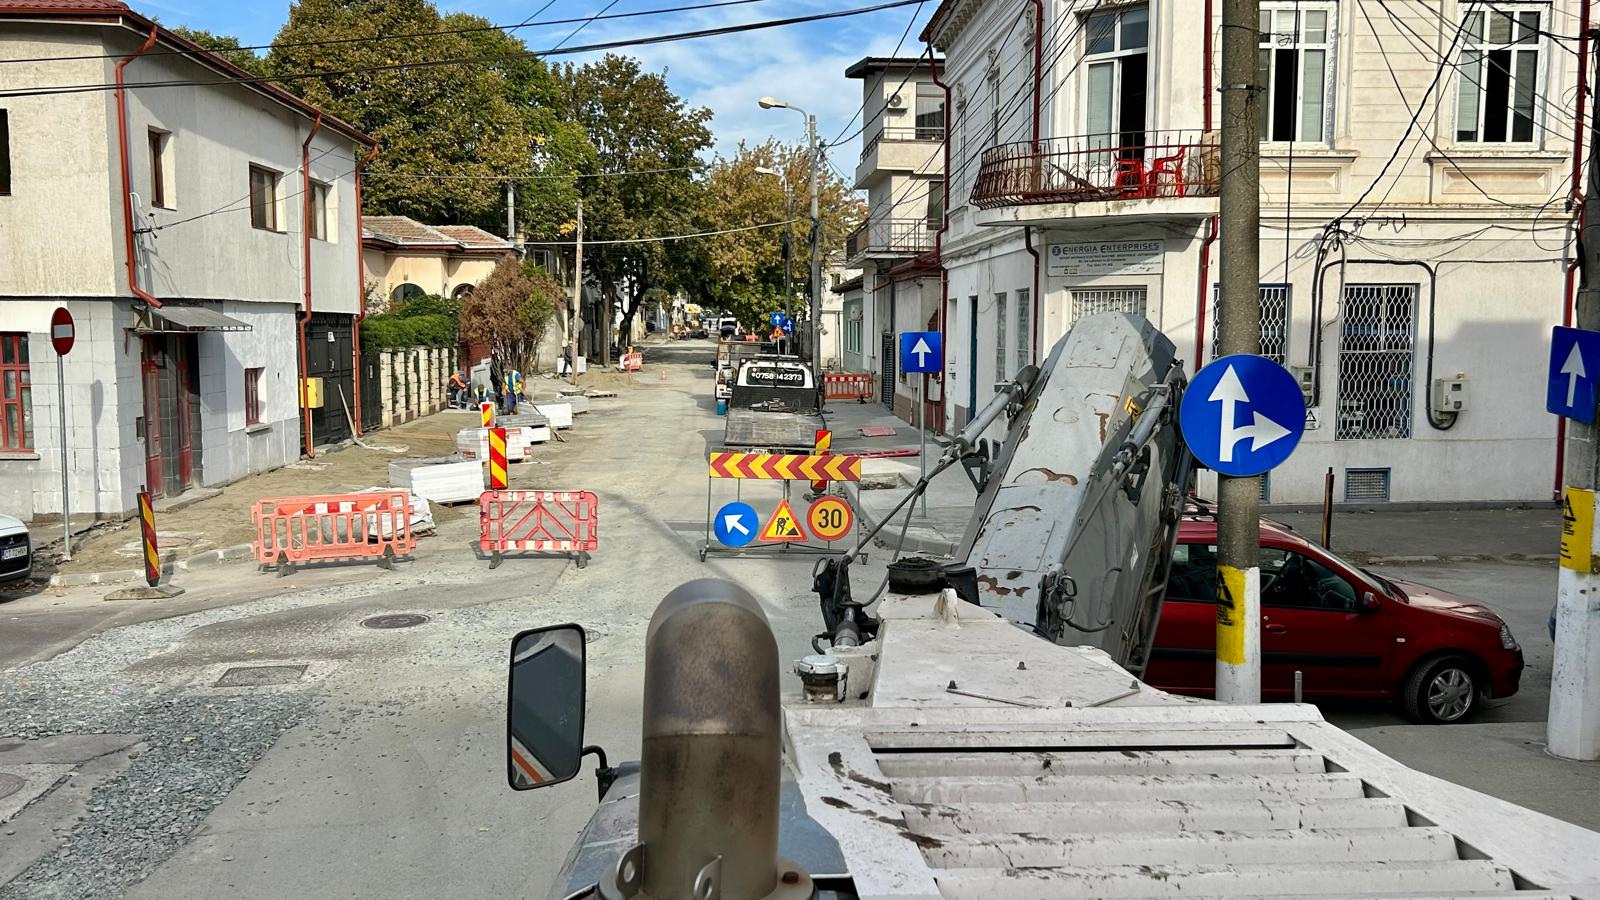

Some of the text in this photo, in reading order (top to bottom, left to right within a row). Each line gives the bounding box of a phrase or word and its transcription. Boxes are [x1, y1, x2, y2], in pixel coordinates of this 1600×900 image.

[1062, 242, 1160, 254] ENERGIA ENTERPRISES
[818, 508, 842, 528] 30
